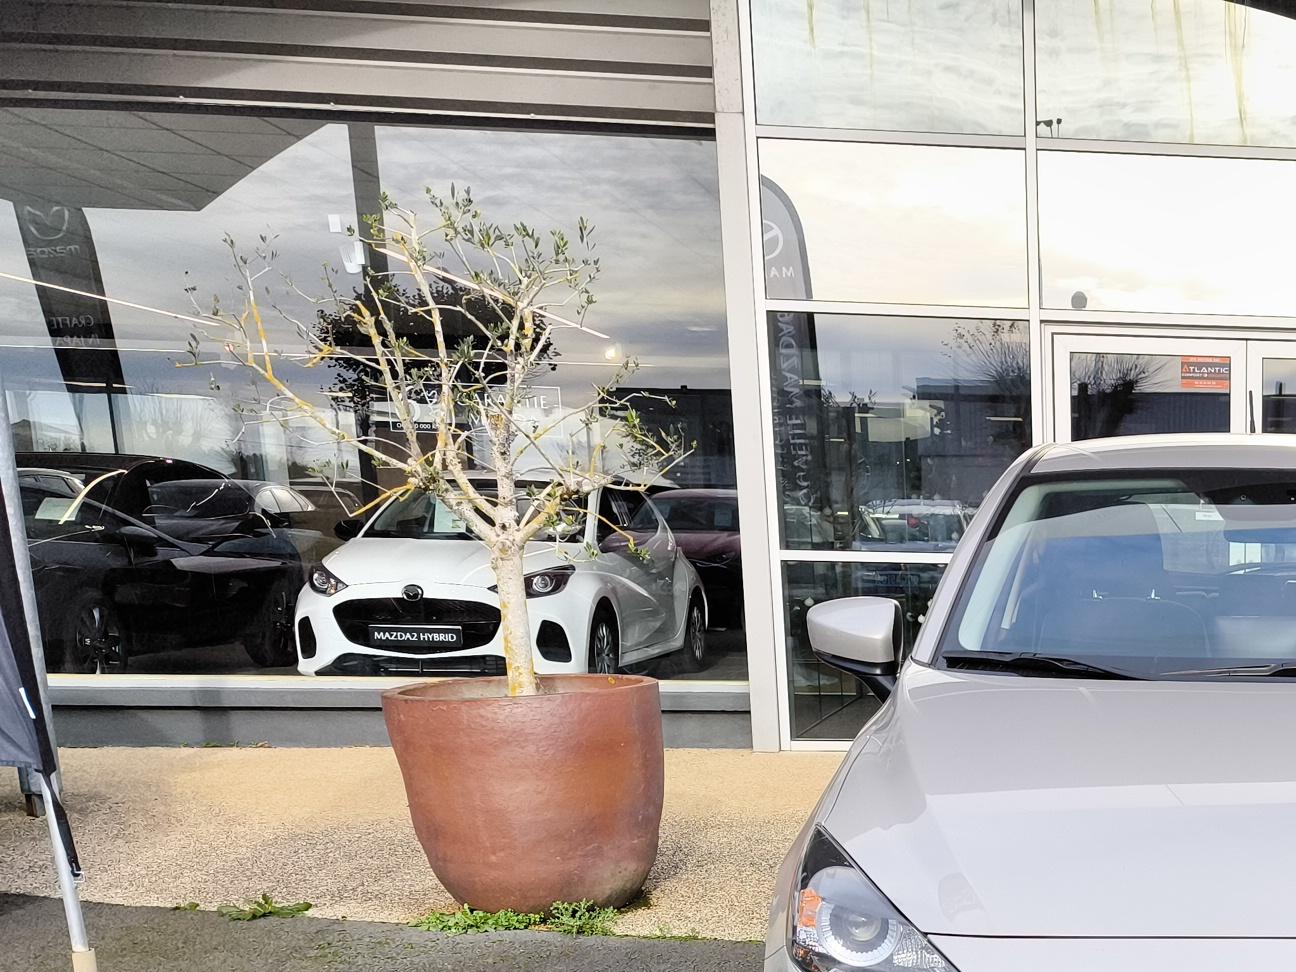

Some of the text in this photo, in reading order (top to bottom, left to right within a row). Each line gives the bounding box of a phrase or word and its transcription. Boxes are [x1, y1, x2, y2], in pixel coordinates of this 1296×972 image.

[1182, 363, 1229, 374] ATLANTIC
[374, 631, 457, 642] MAZDA2 HYBRID
